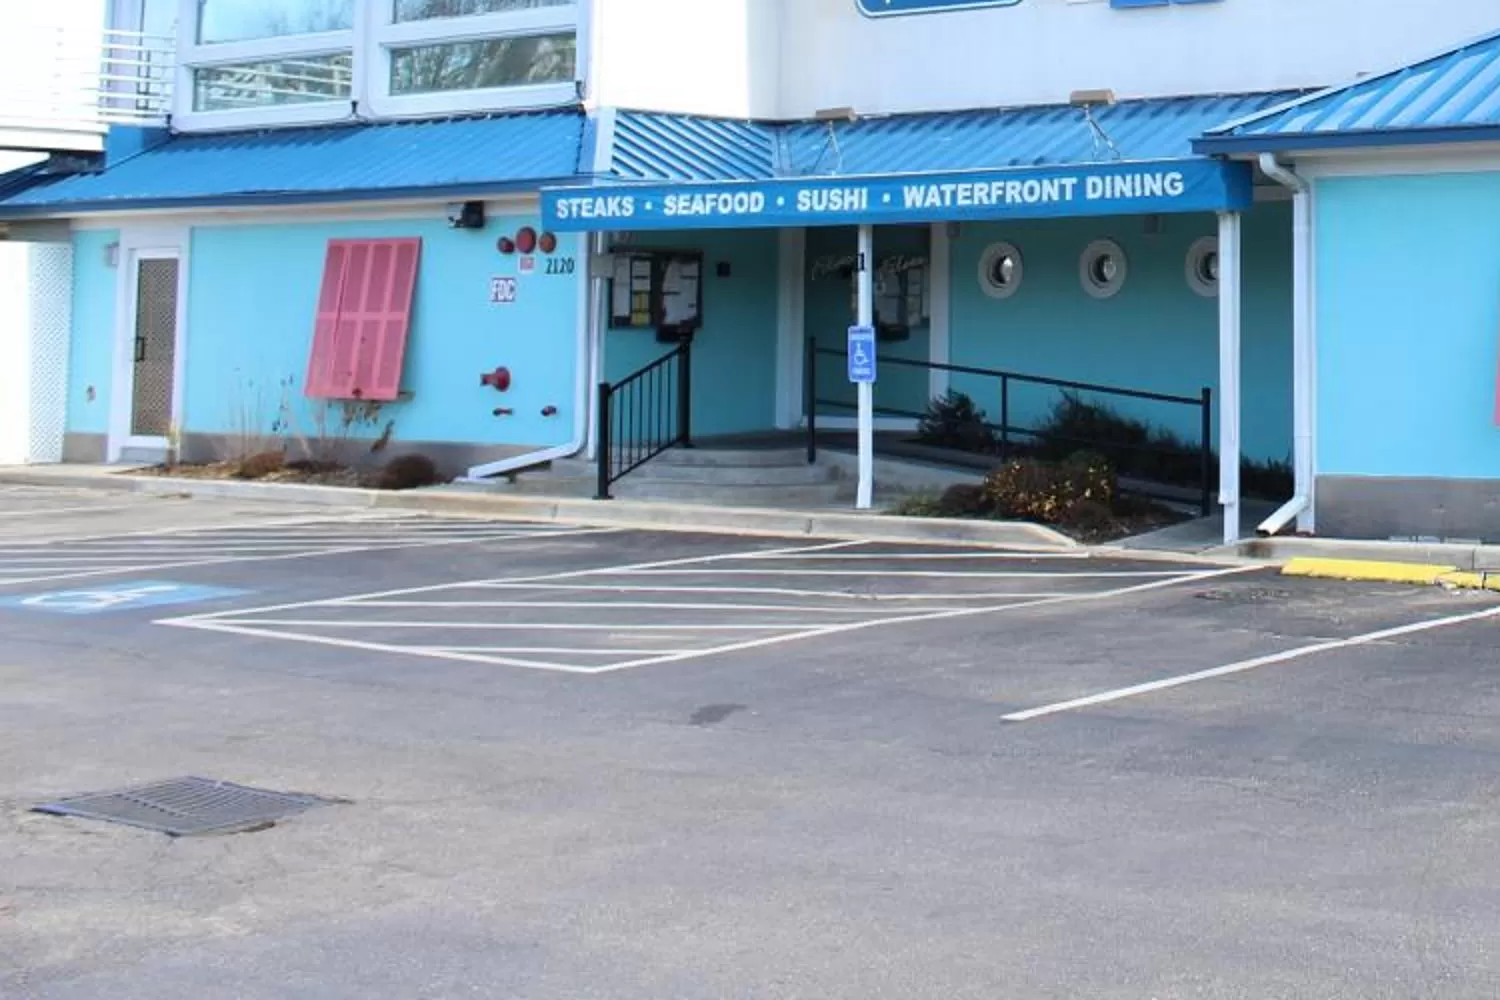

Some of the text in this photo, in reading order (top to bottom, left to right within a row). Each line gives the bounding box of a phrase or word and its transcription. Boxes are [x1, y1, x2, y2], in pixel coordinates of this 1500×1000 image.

[556, 172, 1184, 218] STEAKS SEAFOOD SUSHI WATERFRONT DINING
[545, 257, 575, 274] 2120
